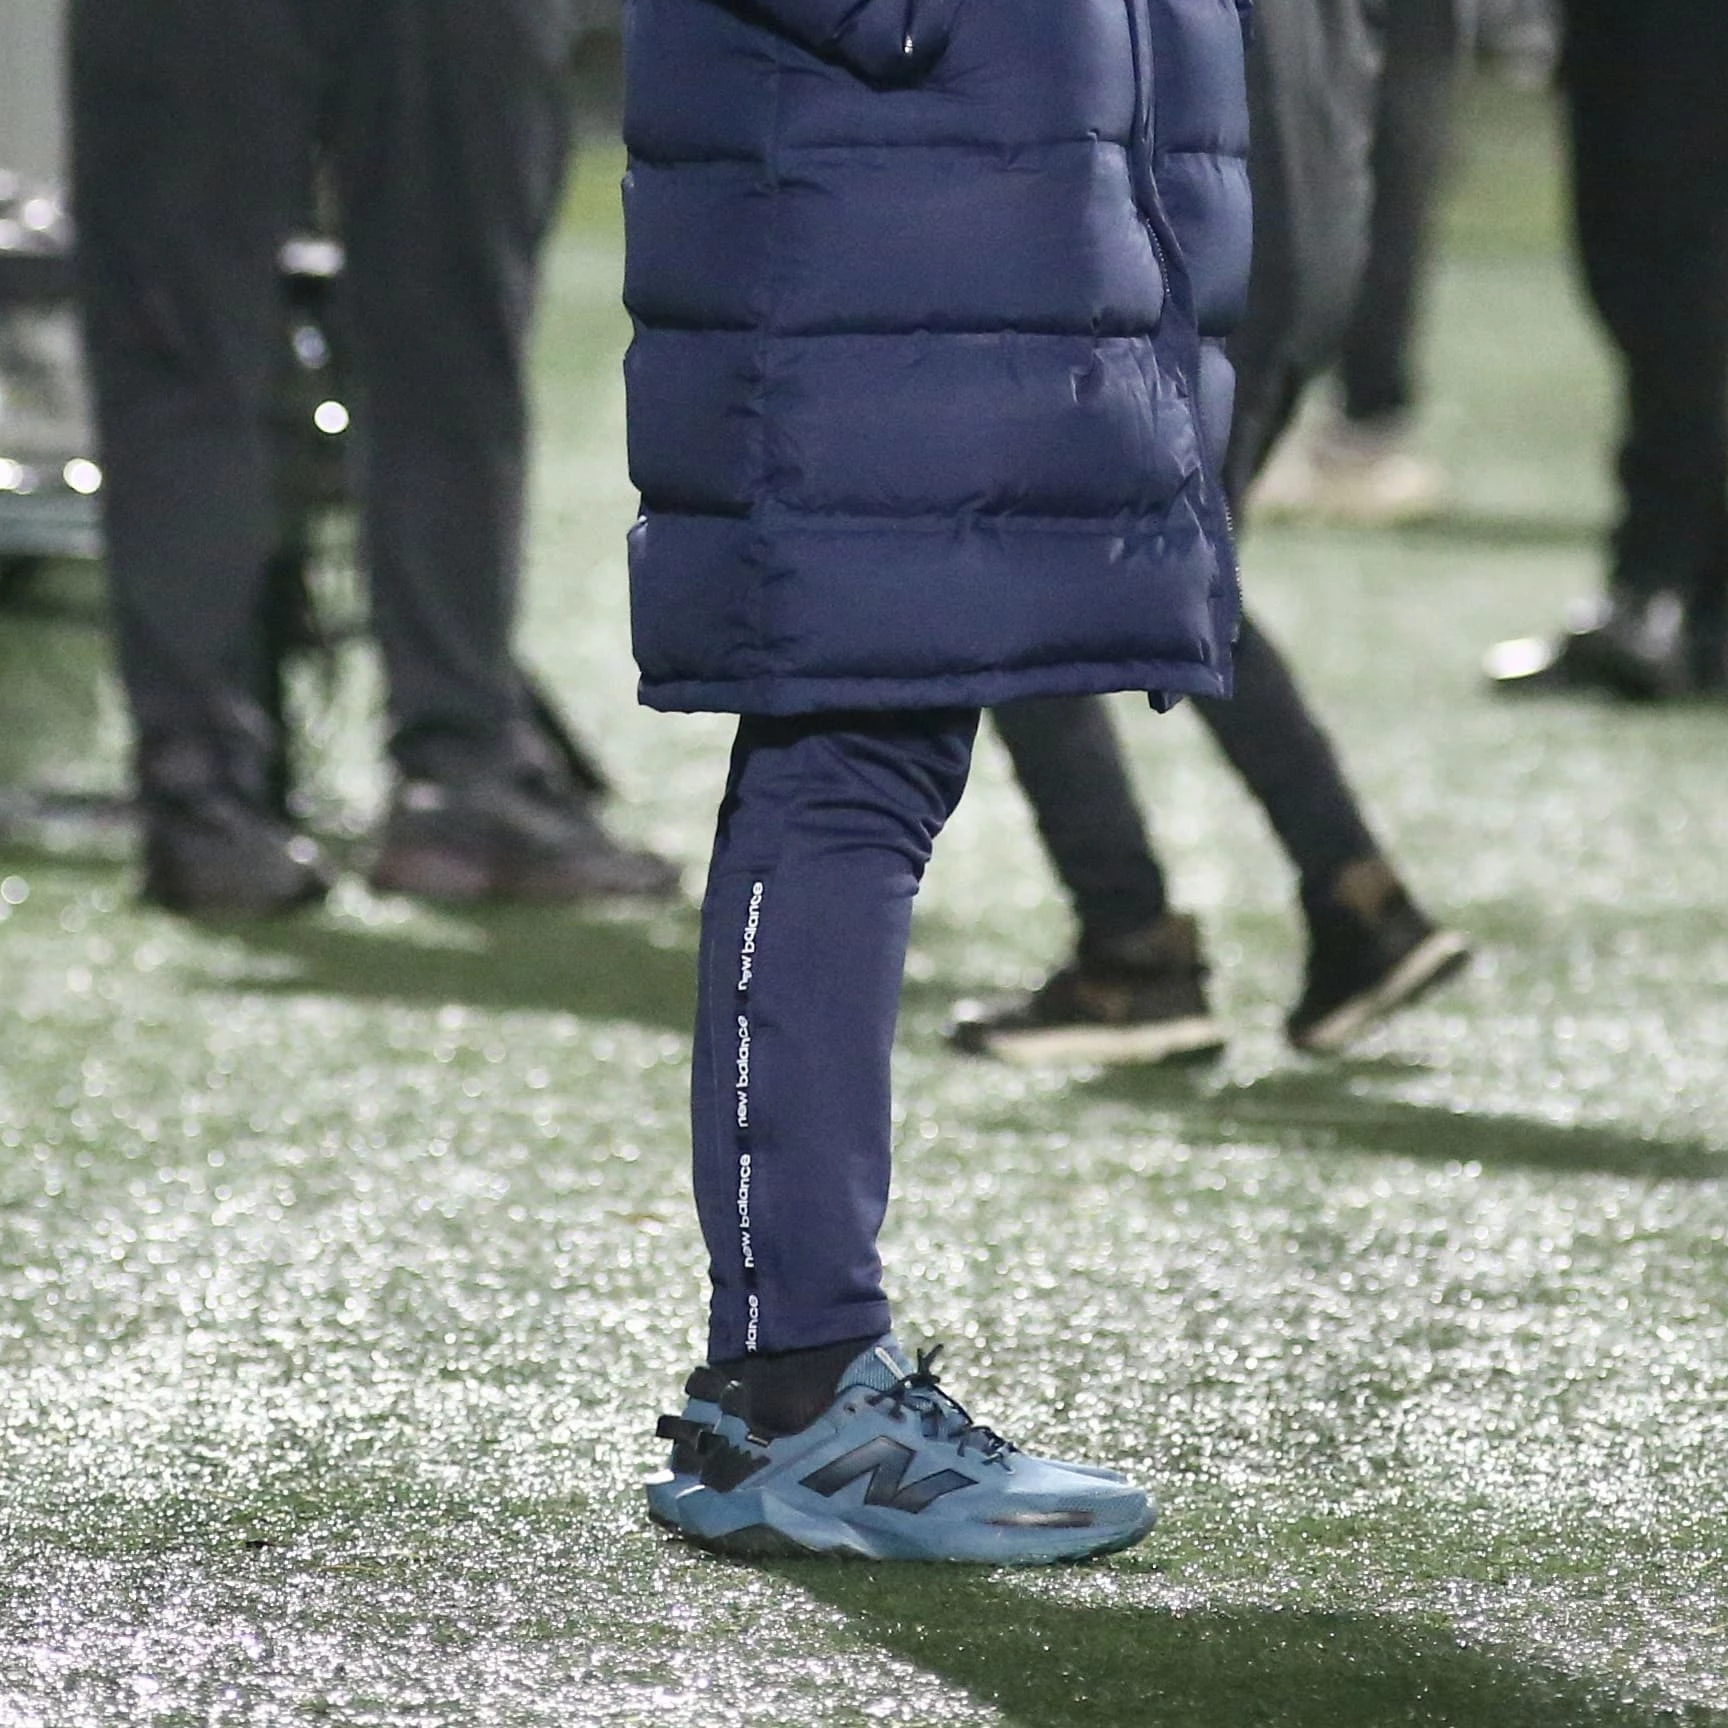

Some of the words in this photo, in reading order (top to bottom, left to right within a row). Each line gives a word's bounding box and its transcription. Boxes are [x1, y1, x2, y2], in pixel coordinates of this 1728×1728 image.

[741, 882, 763, 953] balance
[737, 955, 752, 990] new
[736, 1016, 751, 1087] balance
[737, 1091, 748, 1127] new
[738, 1154, 751, 1227] balance
[741, 1231, 754, 1267] new
